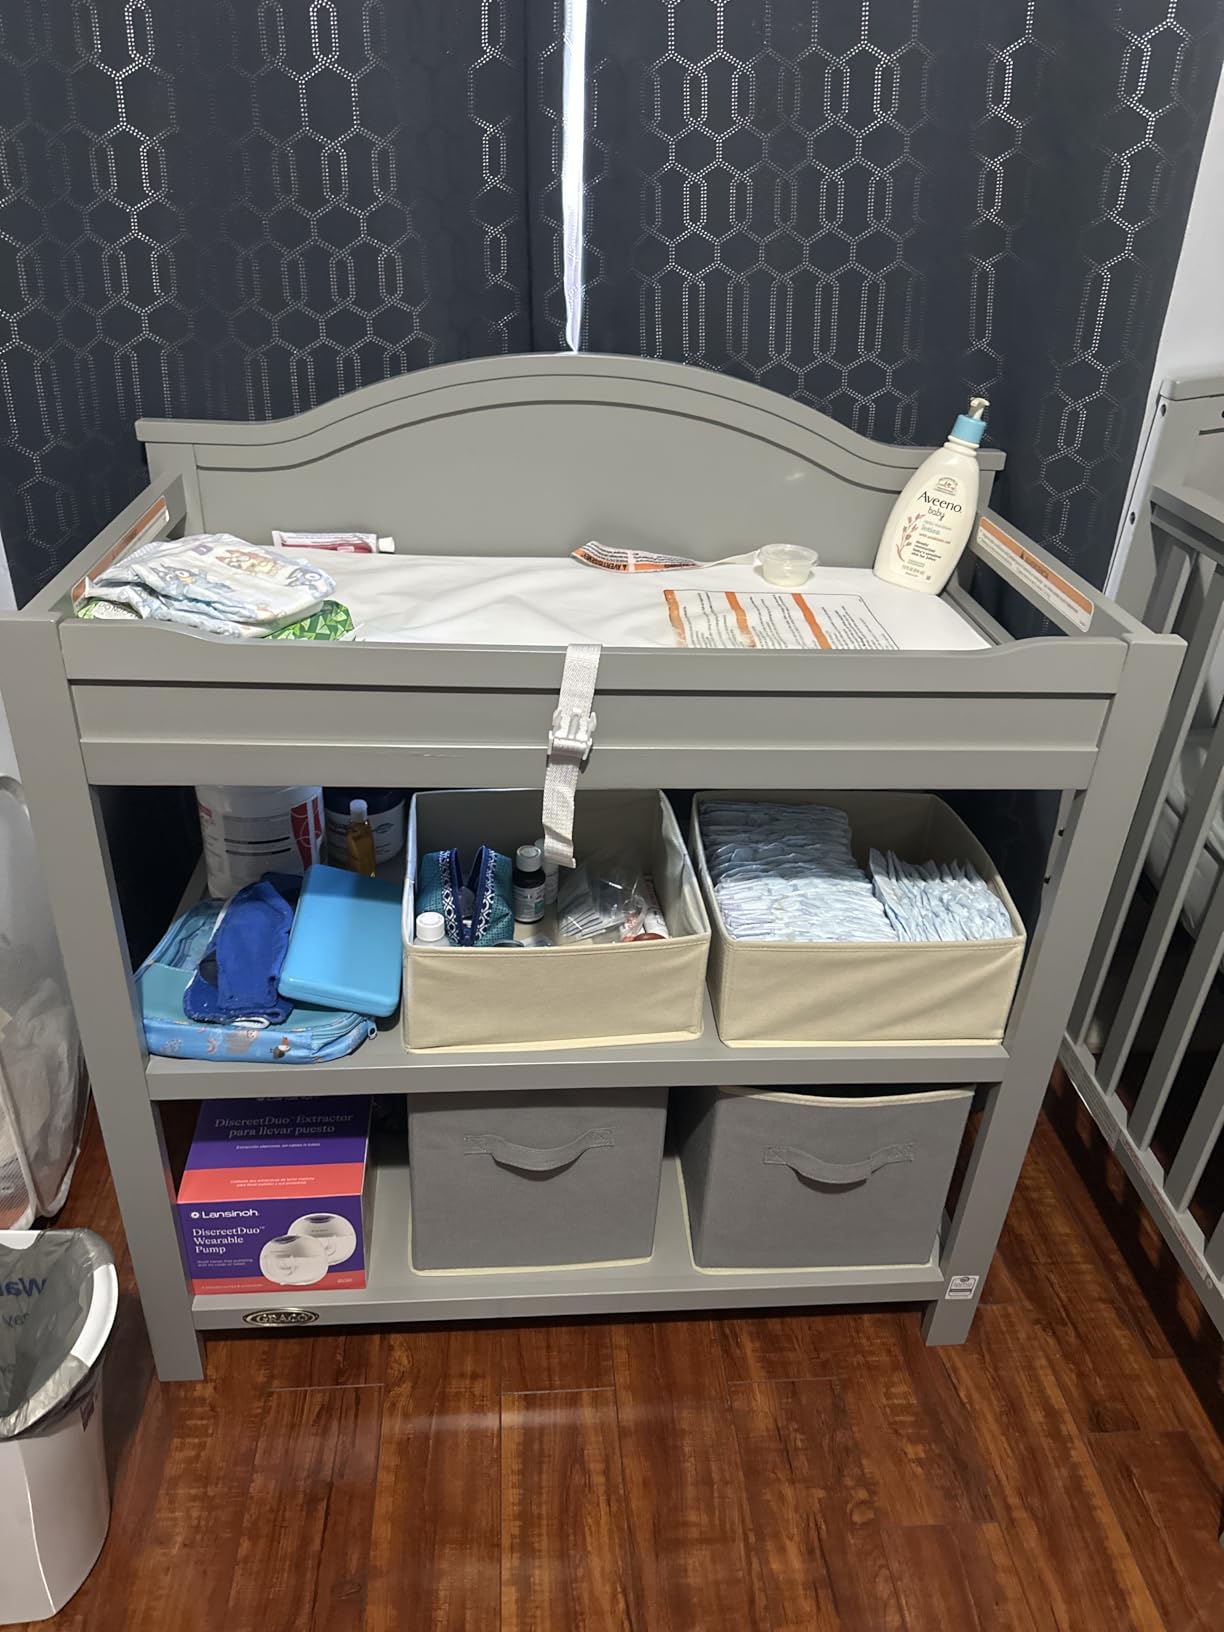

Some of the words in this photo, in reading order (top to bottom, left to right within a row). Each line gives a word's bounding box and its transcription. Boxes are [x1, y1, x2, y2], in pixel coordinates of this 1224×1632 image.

[917, 491, 962, 513] Aveeno
[928, 506, 945, 521] baby
[296, 1114, 354, 1124] Extractor
[228, 1128, 256, 1138] para
[259, 1126, 293, 1136] llevar
[295, 1125, 336, 1136] puesto
[202, 1209, 259, 1219] Lansinoh
[193, 1236, 244, 1245] Wearable
[195, 1246, 226, 1255] Pump
